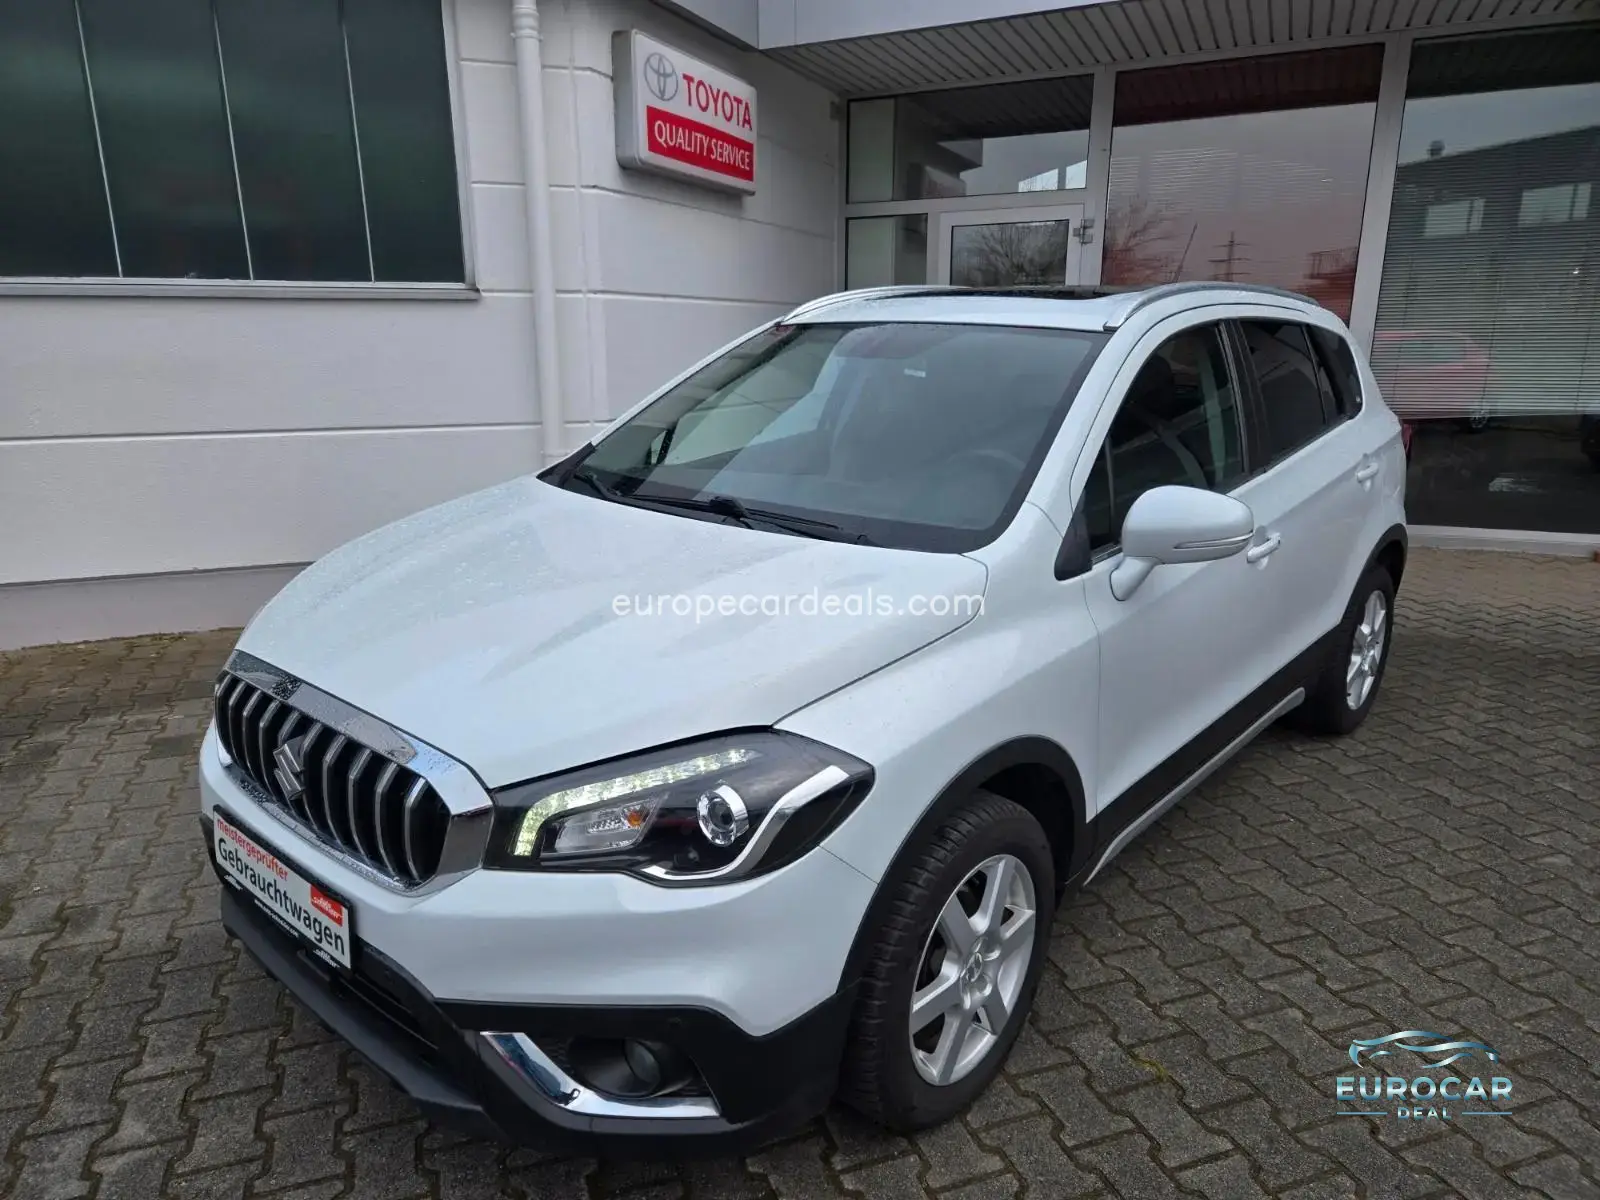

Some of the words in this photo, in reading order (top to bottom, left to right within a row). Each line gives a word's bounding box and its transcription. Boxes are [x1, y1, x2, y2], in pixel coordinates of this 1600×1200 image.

[682, 73, 752, 131] TOYOTA
[654, 120, 709, 156] QUALITY
[711, 139, 750, 170] SERVICE
[218, 838, 345, 955] Gebrauchtwagen
